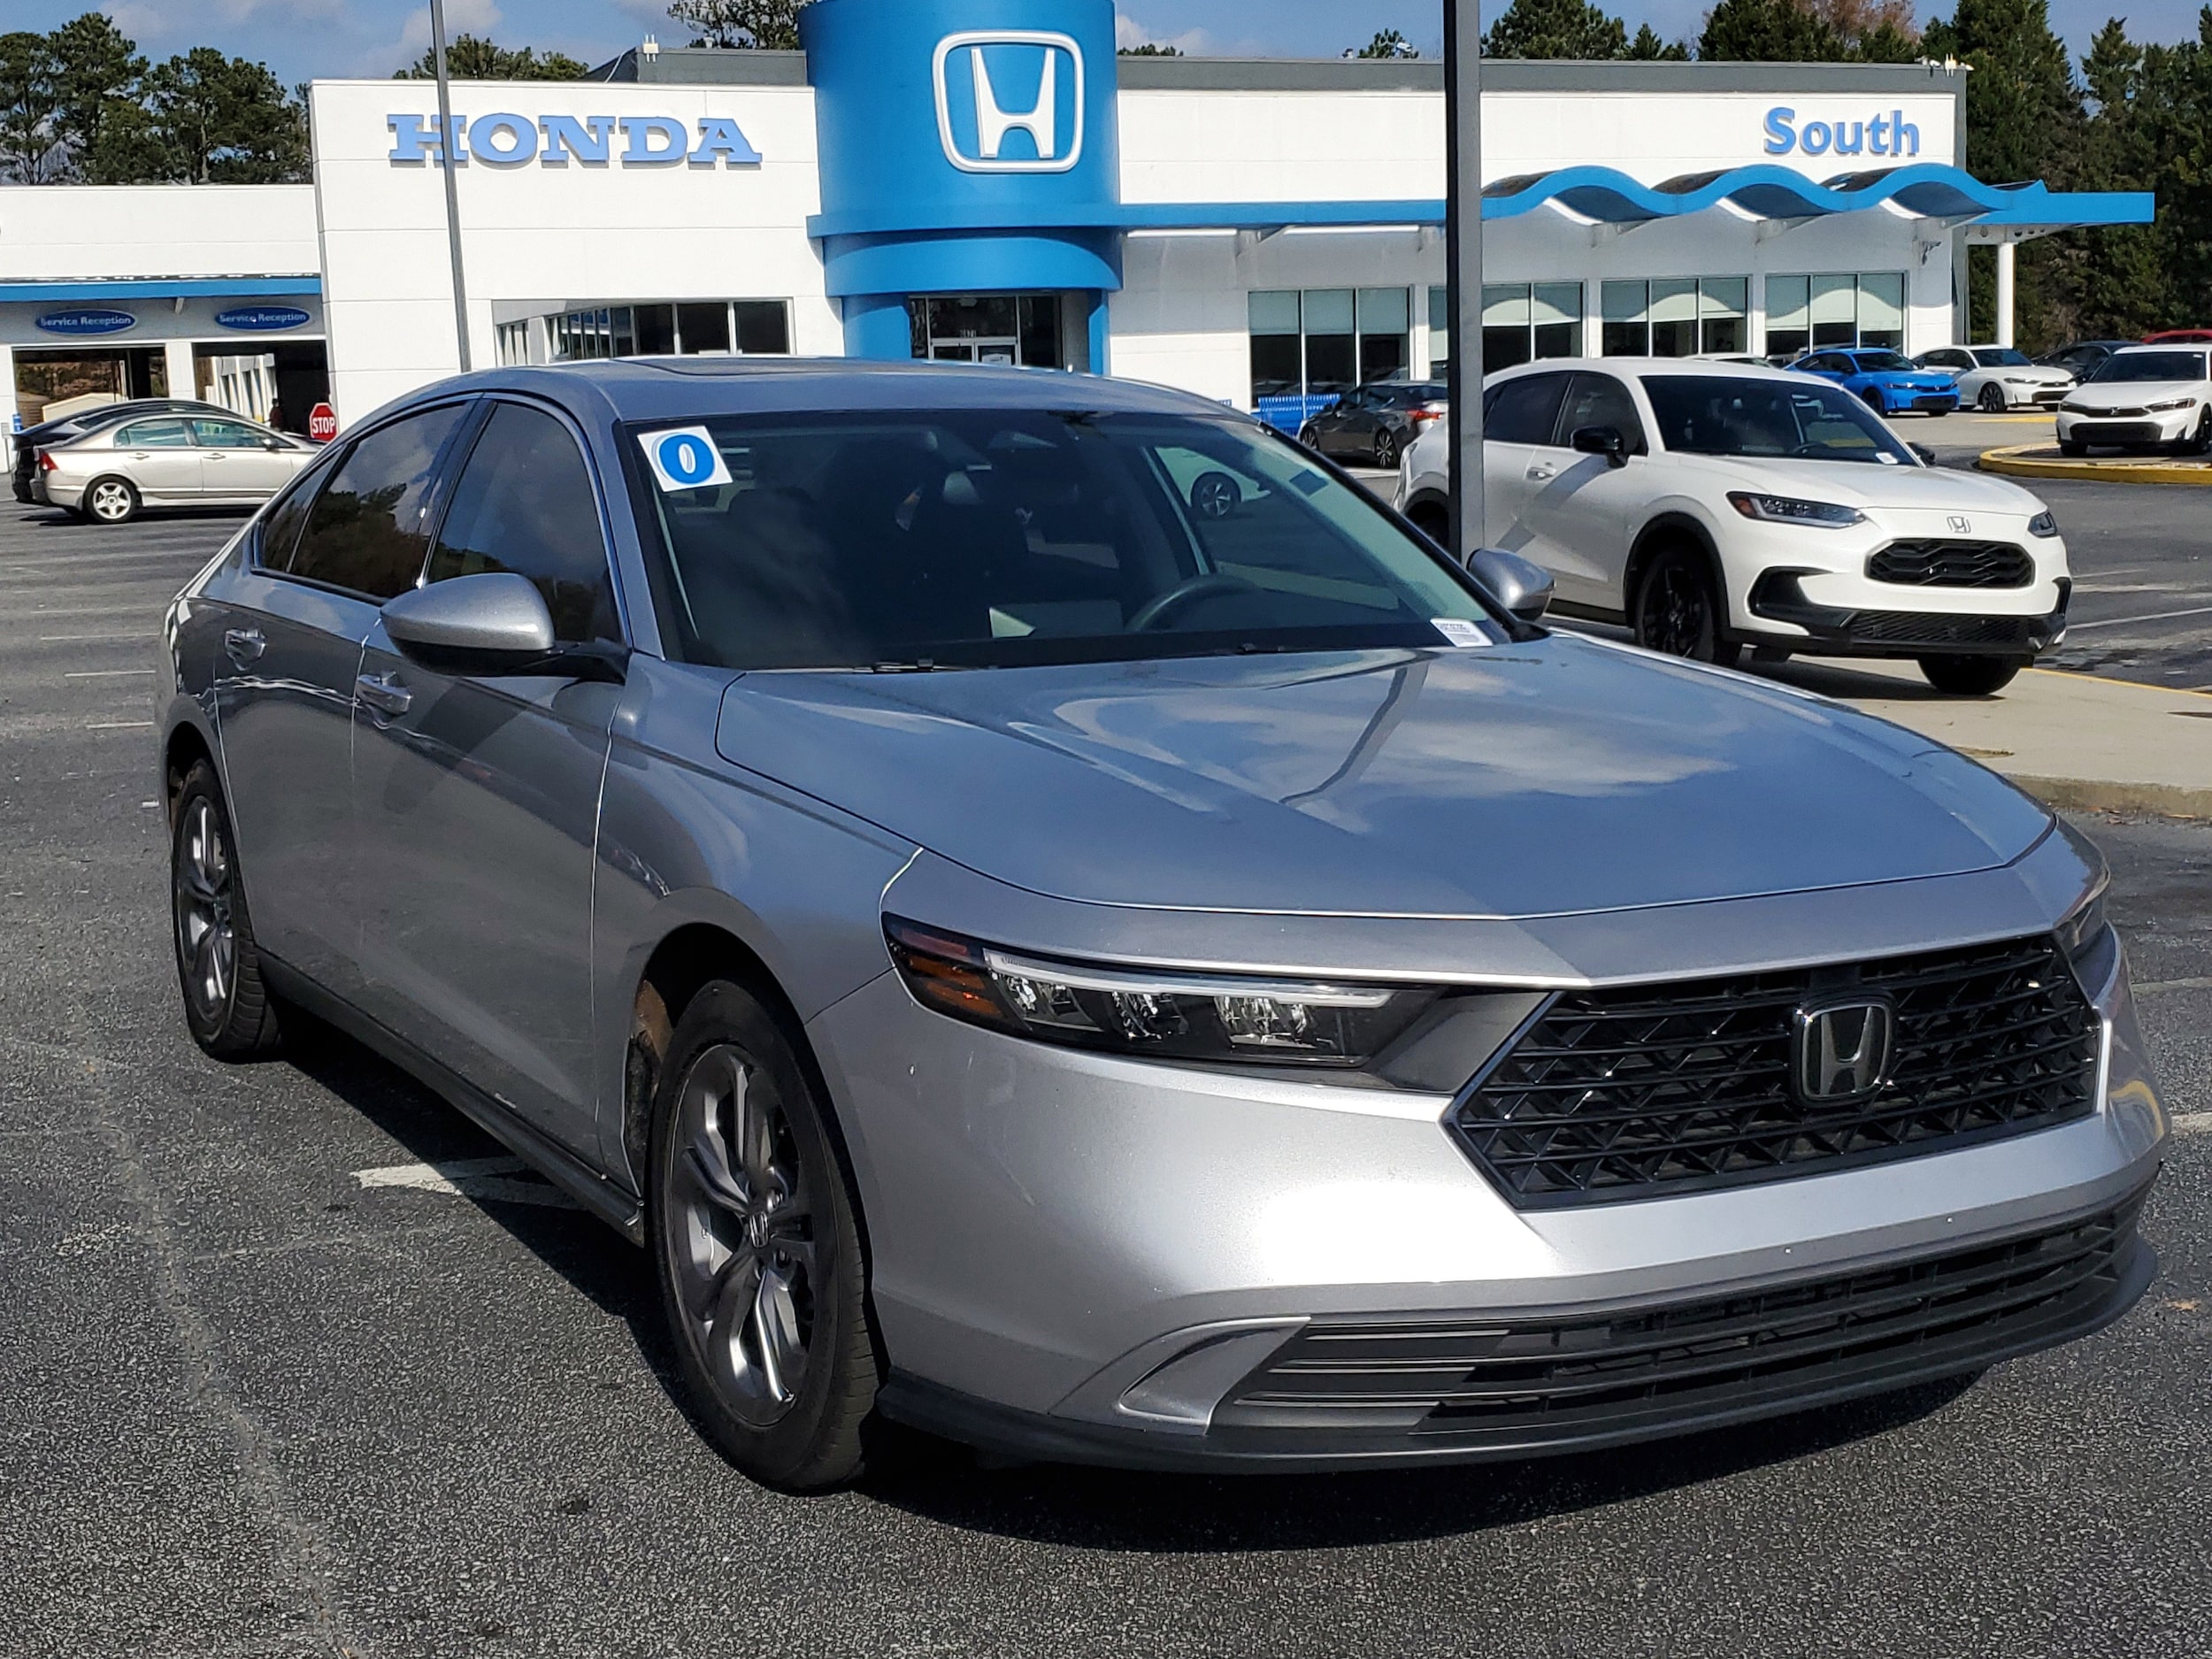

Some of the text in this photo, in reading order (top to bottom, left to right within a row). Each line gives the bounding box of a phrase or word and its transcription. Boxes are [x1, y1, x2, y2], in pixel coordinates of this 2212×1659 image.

[387, 112, 763, 166] HONDA
[1763, 107, 1920, 156] South
[40, 315, 131, 326] Service Reception
[219, 312, 306, 323] Service Reception
[312, 417, 335, 434] STOP
